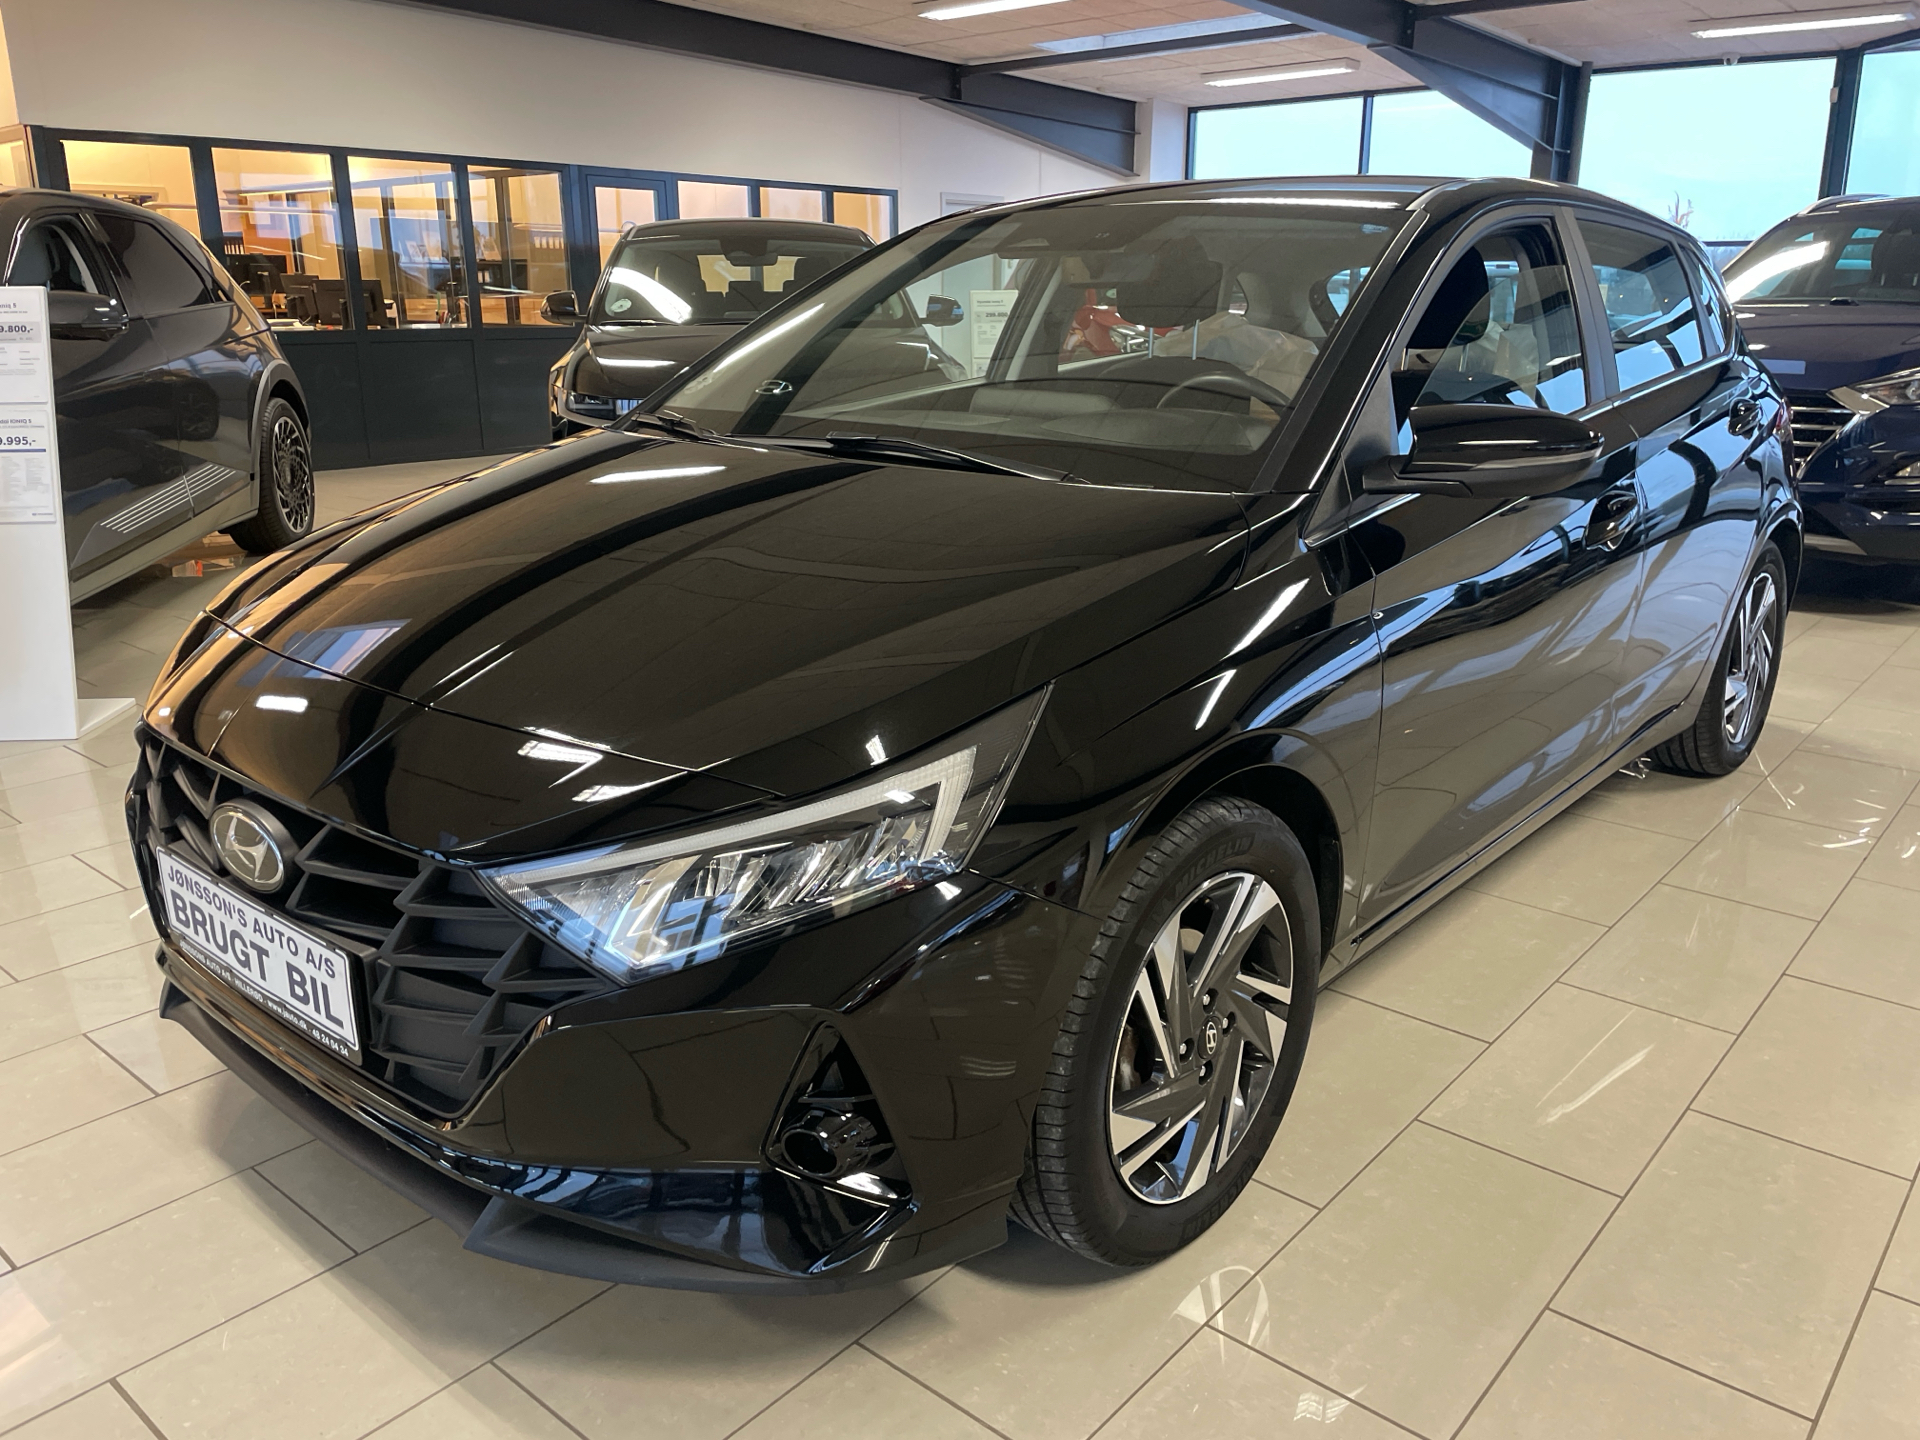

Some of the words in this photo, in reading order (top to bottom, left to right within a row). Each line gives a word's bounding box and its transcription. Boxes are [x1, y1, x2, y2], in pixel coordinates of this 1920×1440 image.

[168, 865, 248, 928] JØNSSON'S
[253, 917, 299, 957] AUTO
[306, 947, 336, 979] A/S
[1175, 836, 1253, 897] MICHELIN
[171, 889, 270, 982] BRUGT
[286, 960, 344, 1030] BIL
